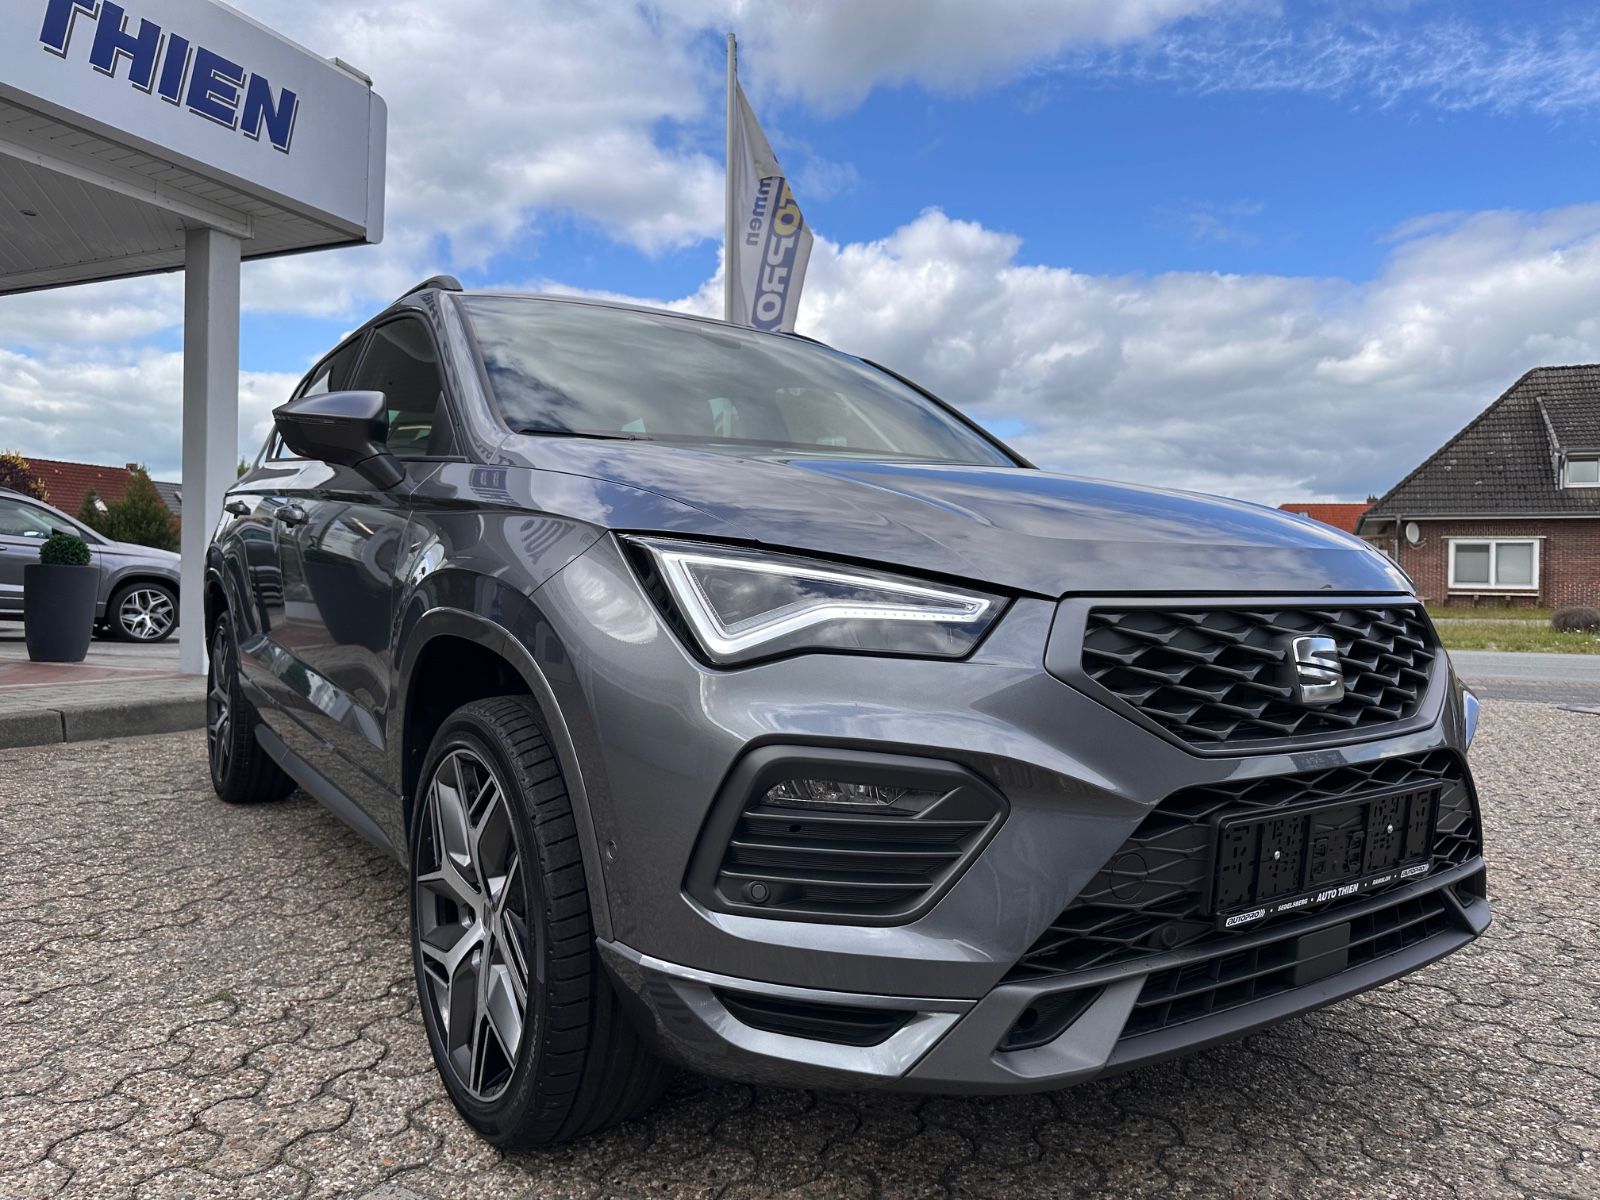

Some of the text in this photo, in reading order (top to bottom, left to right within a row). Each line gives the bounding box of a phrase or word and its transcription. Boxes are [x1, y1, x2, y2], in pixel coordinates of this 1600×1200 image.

[39, 0, 299, 154] THIEN
[1226, 909, 1263, 927] AUTOPRO
[1316, 889, 1337, 903] AUTO
[1337, 882, 1359, 897] THIEN
